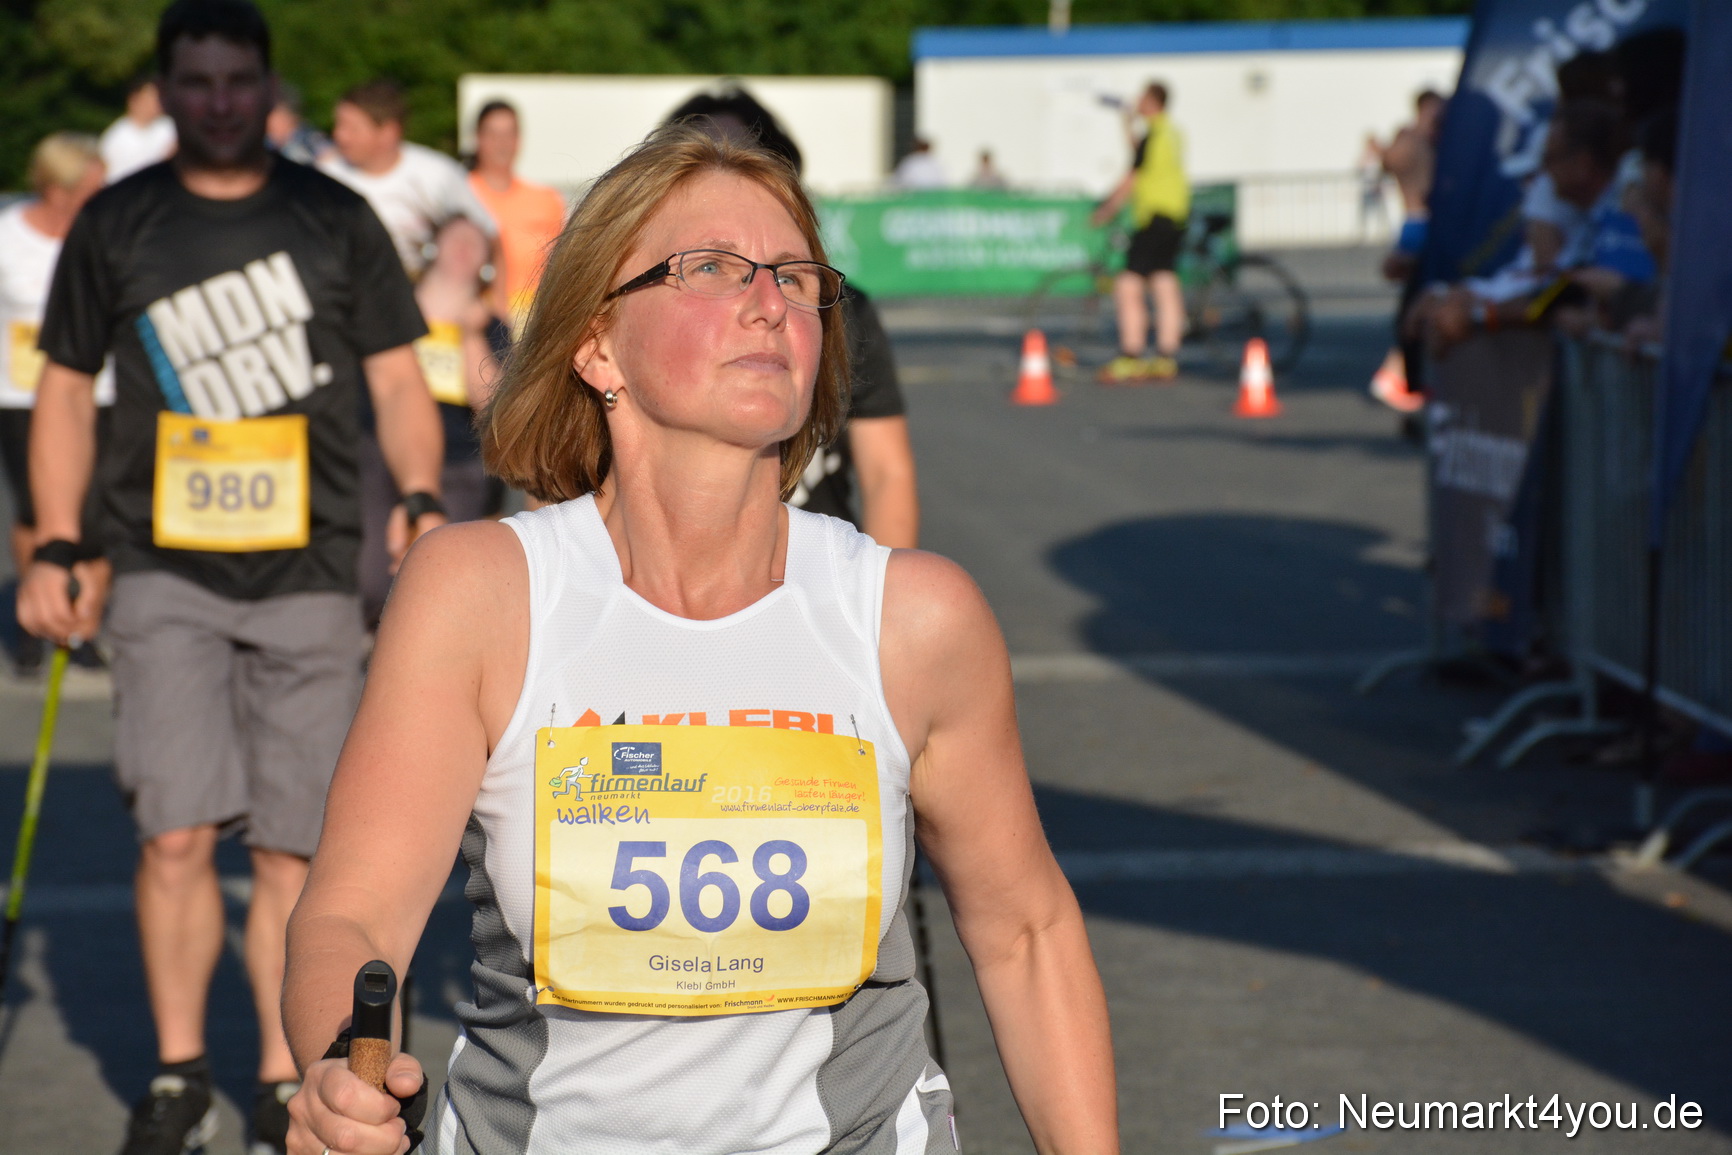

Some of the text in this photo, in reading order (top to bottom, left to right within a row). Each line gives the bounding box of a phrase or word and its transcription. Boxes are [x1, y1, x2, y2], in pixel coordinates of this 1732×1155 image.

[146, 250, 315, 371] MDN
[186, 470, 276, 512] 980
[620, 749, 655, 759] Fischer
[590, 773, 708, 792] firmenlauf
[774, 776, 857, 789] Gesunde Firmen
[590, 792, 641, 801] neumarkt
[711, 785, 773, 804] 2016
[794, 789, 866, 803] laufen länger!
[556, 802, 651, 826] walken
[607, 839, 811, 933] 568
[648, 954, 764, 974] Gisela Lang
[676, 979, 736, 991] Klebl GmbH
[561, 996, 603, 1006] Startnummern
[627, 1001, 654, 1009] gedruckt
[667, 1002, 709, 1010] personalisiert
[724, 999, 763, 1008] Frischmann
